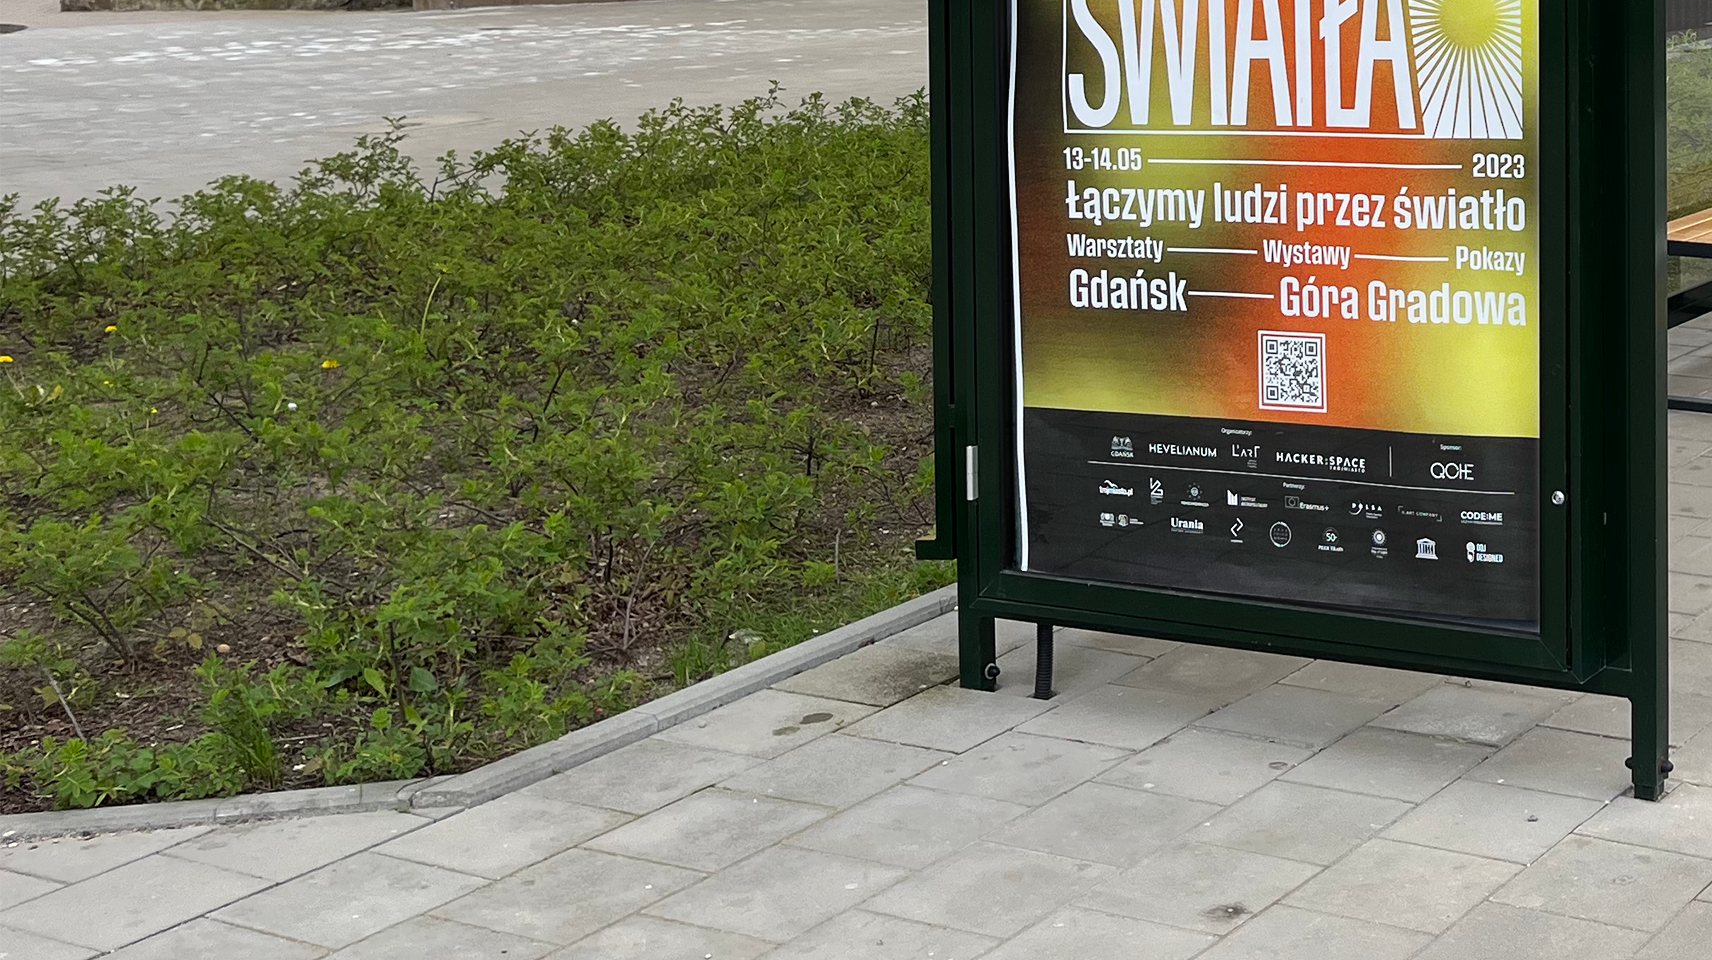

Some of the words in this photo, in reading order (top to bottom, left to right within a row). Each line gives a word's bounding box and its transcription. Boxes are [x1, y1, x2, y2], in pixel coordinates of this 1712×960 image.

[1063, 147, 1142, 172] 13-14.05
[1472, 153, 1525, 179] 2023
[1065, 179, 1206, 229] Łączymy
[1213, 182, 1288, 226] ludzi
[1296, 193, 1386, 232] przez
[1393, 185, 1526, 232] światło
[1066, 234, 1164, 263] Warsztaty
[1262, 239, 1351, 271] Wystawy
[1455, 245, 1526, 277] Pokazy
[1068, 268, 1188, 312] Gdańsk
[1279, 276, 1359, 319] Góra
[1367, 279, 1527, 327] Gradowa
[1148, 443, 1217, 458] HEVELIANUM
[1276, 451, 1366, 469] HACKER:SPACE
[1170, 517, 1204, 530] Urania
